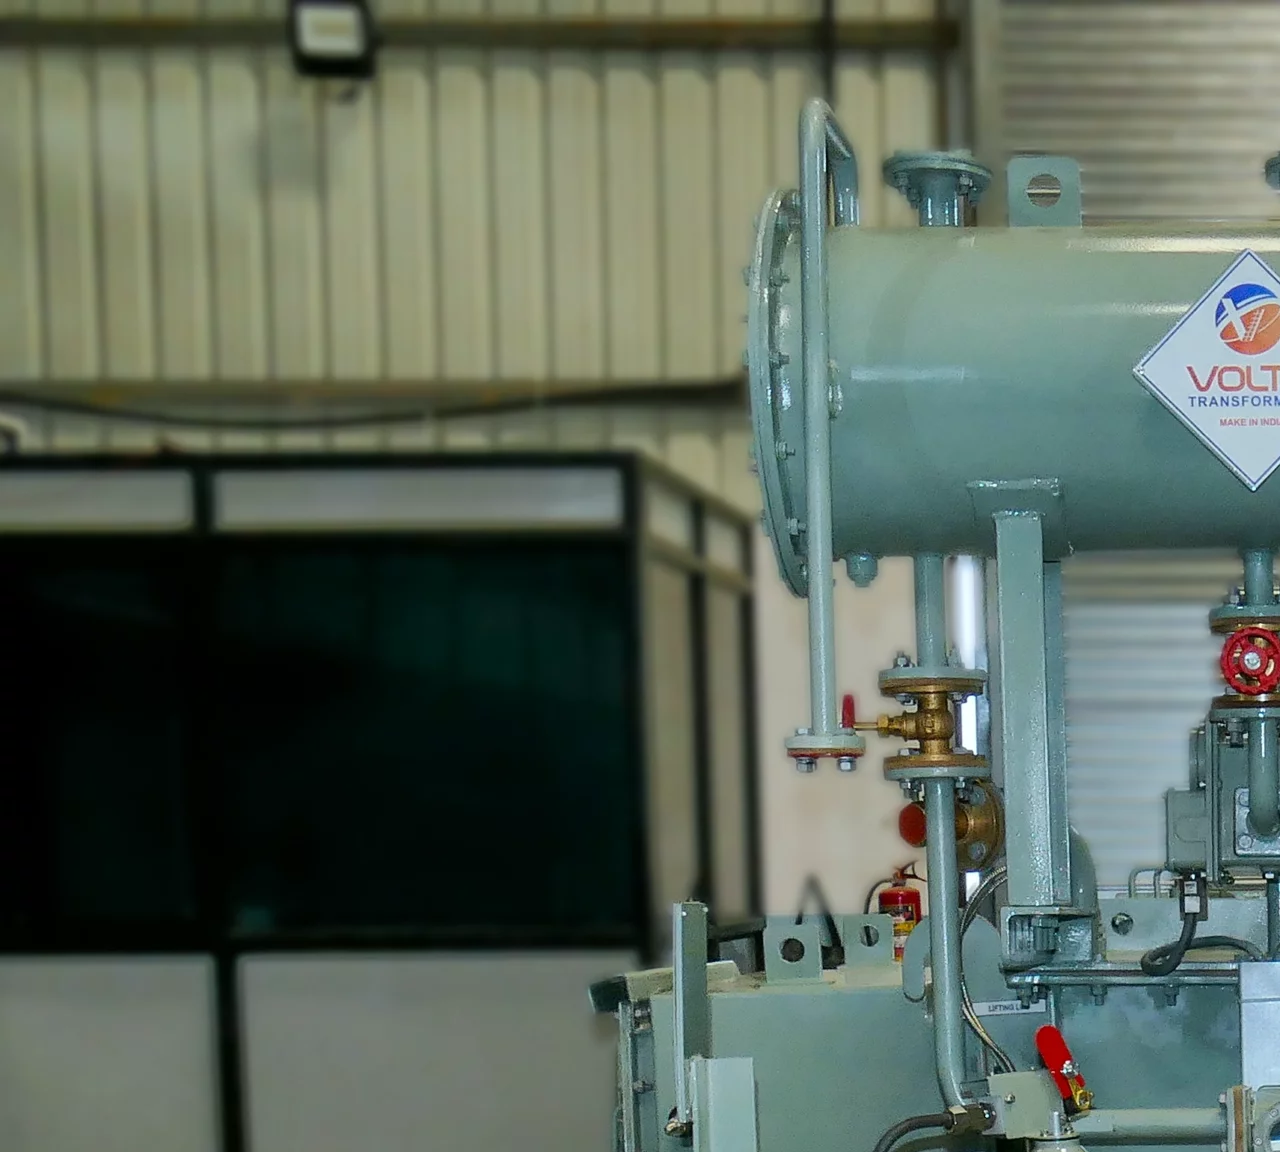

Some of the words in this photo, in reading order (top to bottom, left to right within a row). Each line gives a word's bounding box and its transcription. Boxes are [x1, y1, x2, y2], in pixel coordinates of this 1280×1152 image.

[1219, 418, 1247, 427] MAKE
[1249, 418, 1259, 427] IN
[988, 1004, 1015, 1012] LIFTING
